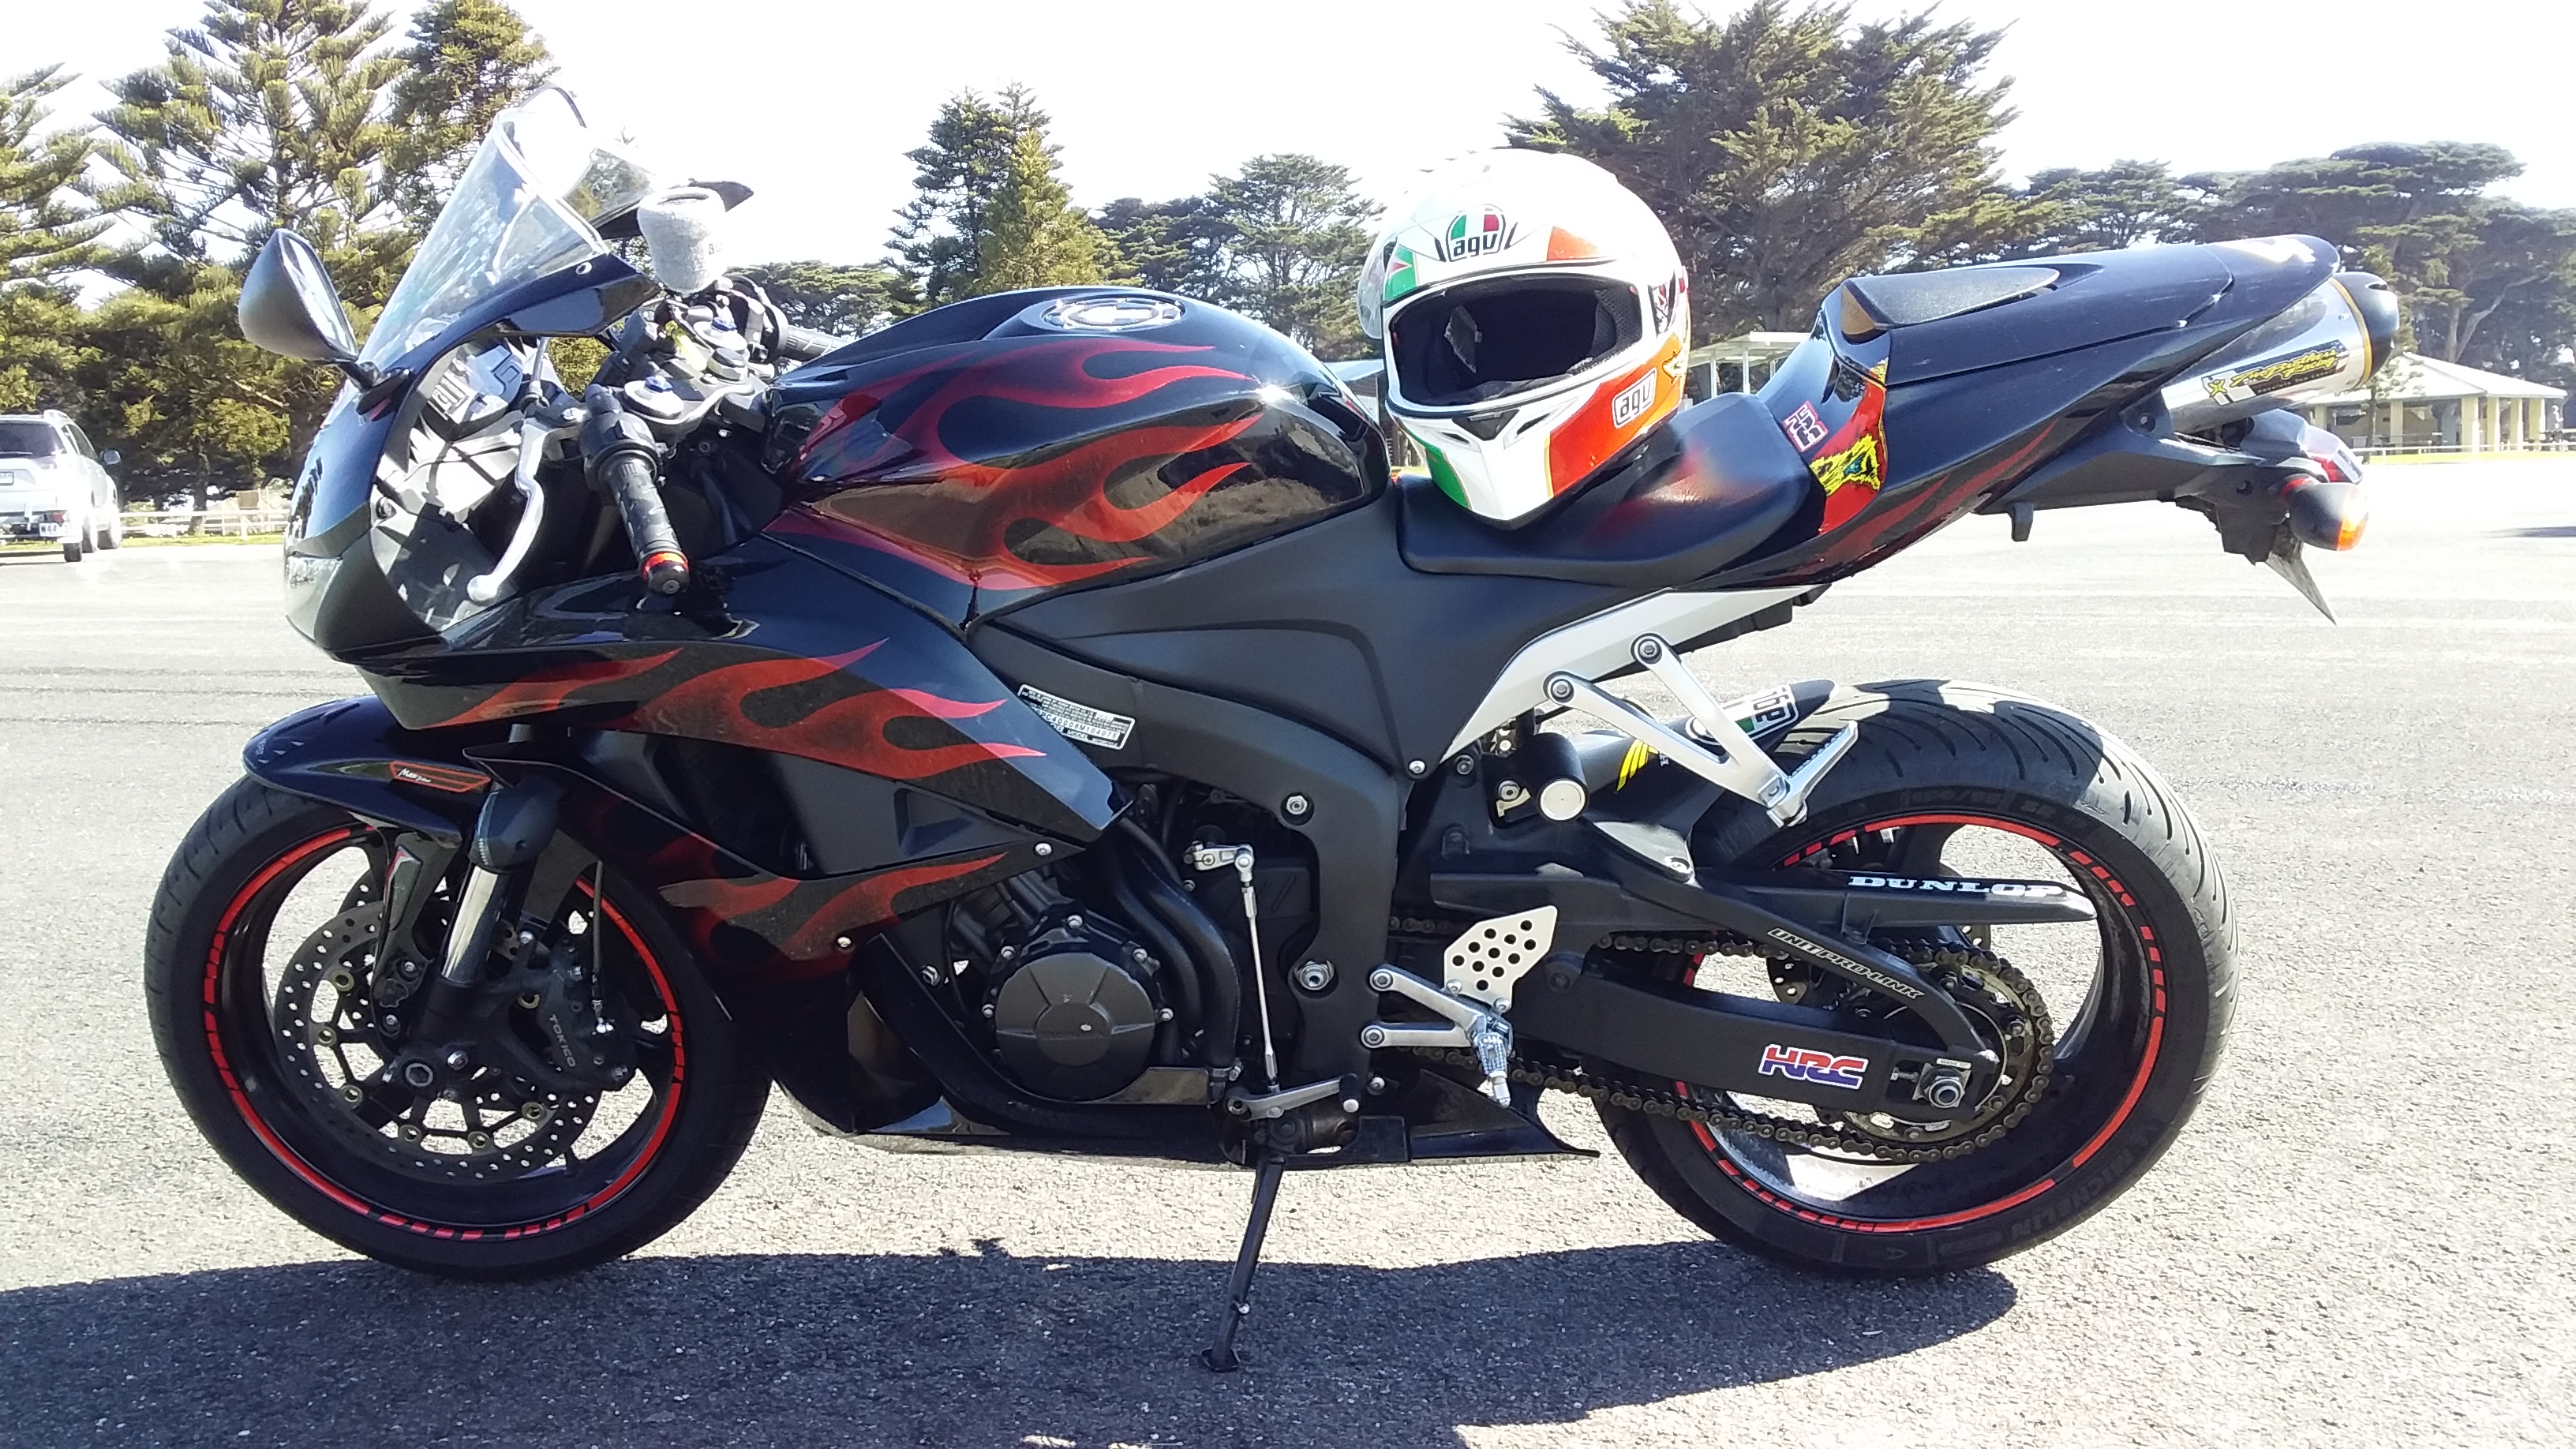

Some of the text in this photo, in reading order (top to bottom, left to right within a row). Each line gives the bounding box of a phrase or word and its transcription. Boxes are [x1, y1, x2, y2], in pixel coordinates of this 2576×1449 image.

[1619, 382, 1653, 417] agv
[1848, 876, 2064, 897] DUNLOP
[549, 1013, 576, 1067] TOKICO
[1759, 1043, 1868, 1090] HRC
[2011, 1150, 2133, 1241] MICHELIN
